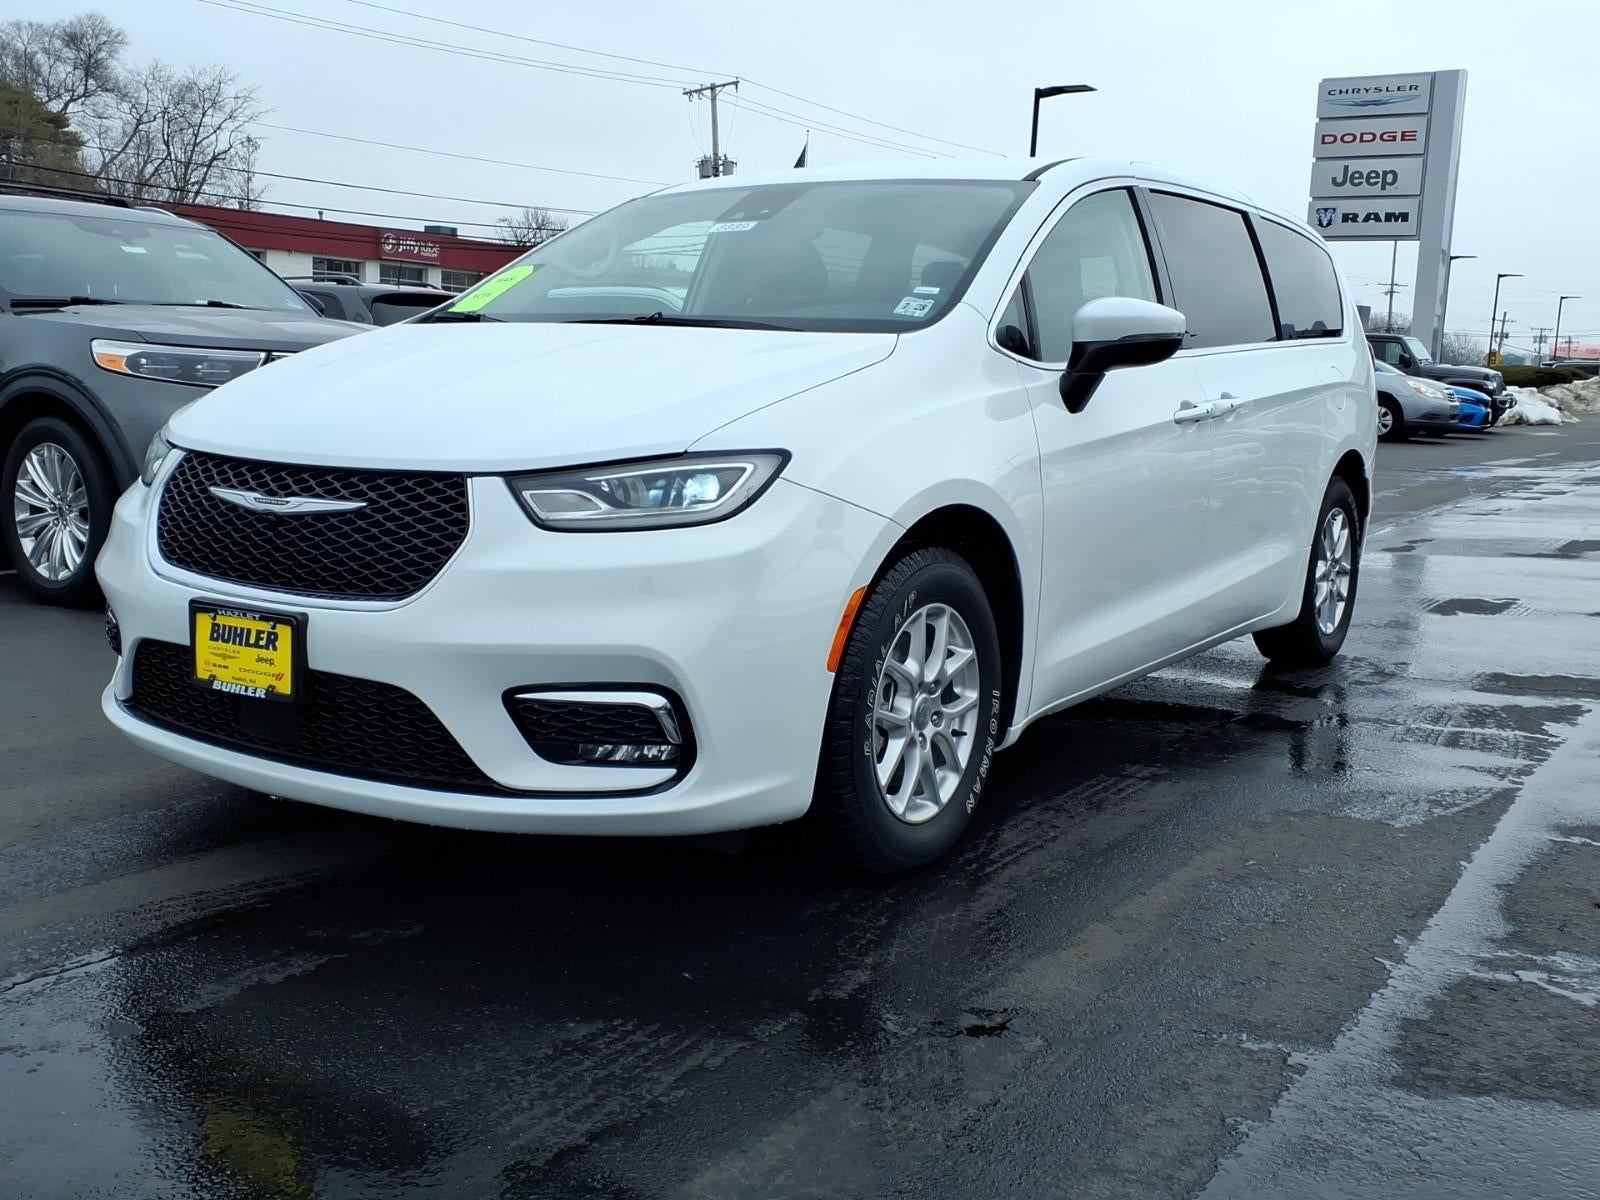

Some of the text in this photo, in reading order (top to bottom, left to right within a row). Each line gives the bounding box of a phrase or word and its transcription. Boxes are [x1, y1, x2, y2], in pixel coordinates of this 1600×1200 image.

[1327, 84, 1420, 96] CHRYSLER
[1320, 130, 1418, 145] DODGE
[1331, 164, 1399, 191] Jeep
[1341, 211, 1410, 223] RAM
[217, 609, 260, 620] HAZLET
[209, 622, 279, 652] BUHLER
[211, 662, 229, 670] RAM
[255, 653, 275, 667] Jeep
[238, 667, 276, 678] DODGE
[212, 680, 267, 698] BUHLER
[965, 690, 1000, 814] IRONMAN
